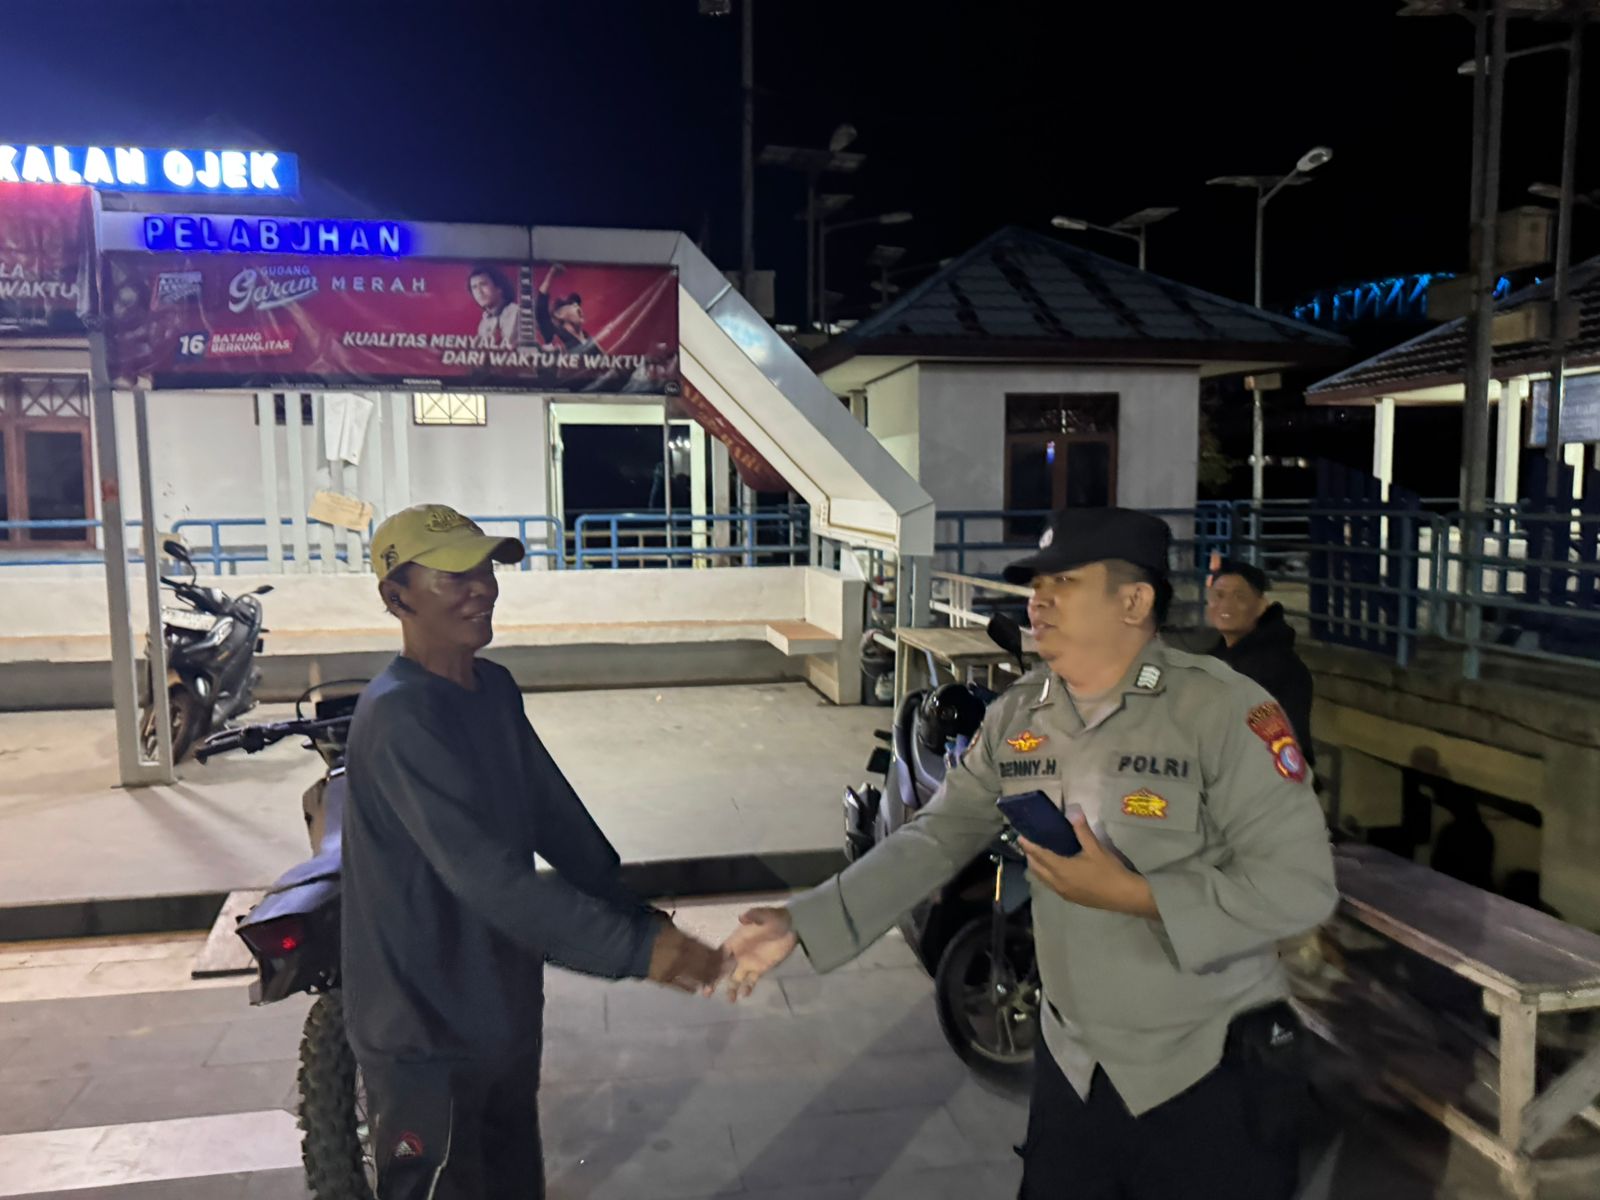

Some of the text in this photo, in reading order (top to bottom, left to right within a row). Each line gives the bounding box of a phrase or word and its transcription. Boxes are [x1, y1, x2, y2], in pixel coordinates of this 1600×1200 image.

[163, 149, 280, 189] OJEK
[259, 265, 310, 276] GUDANG
[228, 268, 319, 313] Garam
[331, 276, 426, 292] MERAH
[179, 332, 261, 354] 16 BATANG
[211, 340, 290, 353] BERKUALITAS
[343, 331, 513, 350] KUALITAS MENYALA
[441, 351, 646, 370] DARI WAKTU KE WAKTU
[1118, 755, 1188, 777] POLRI
